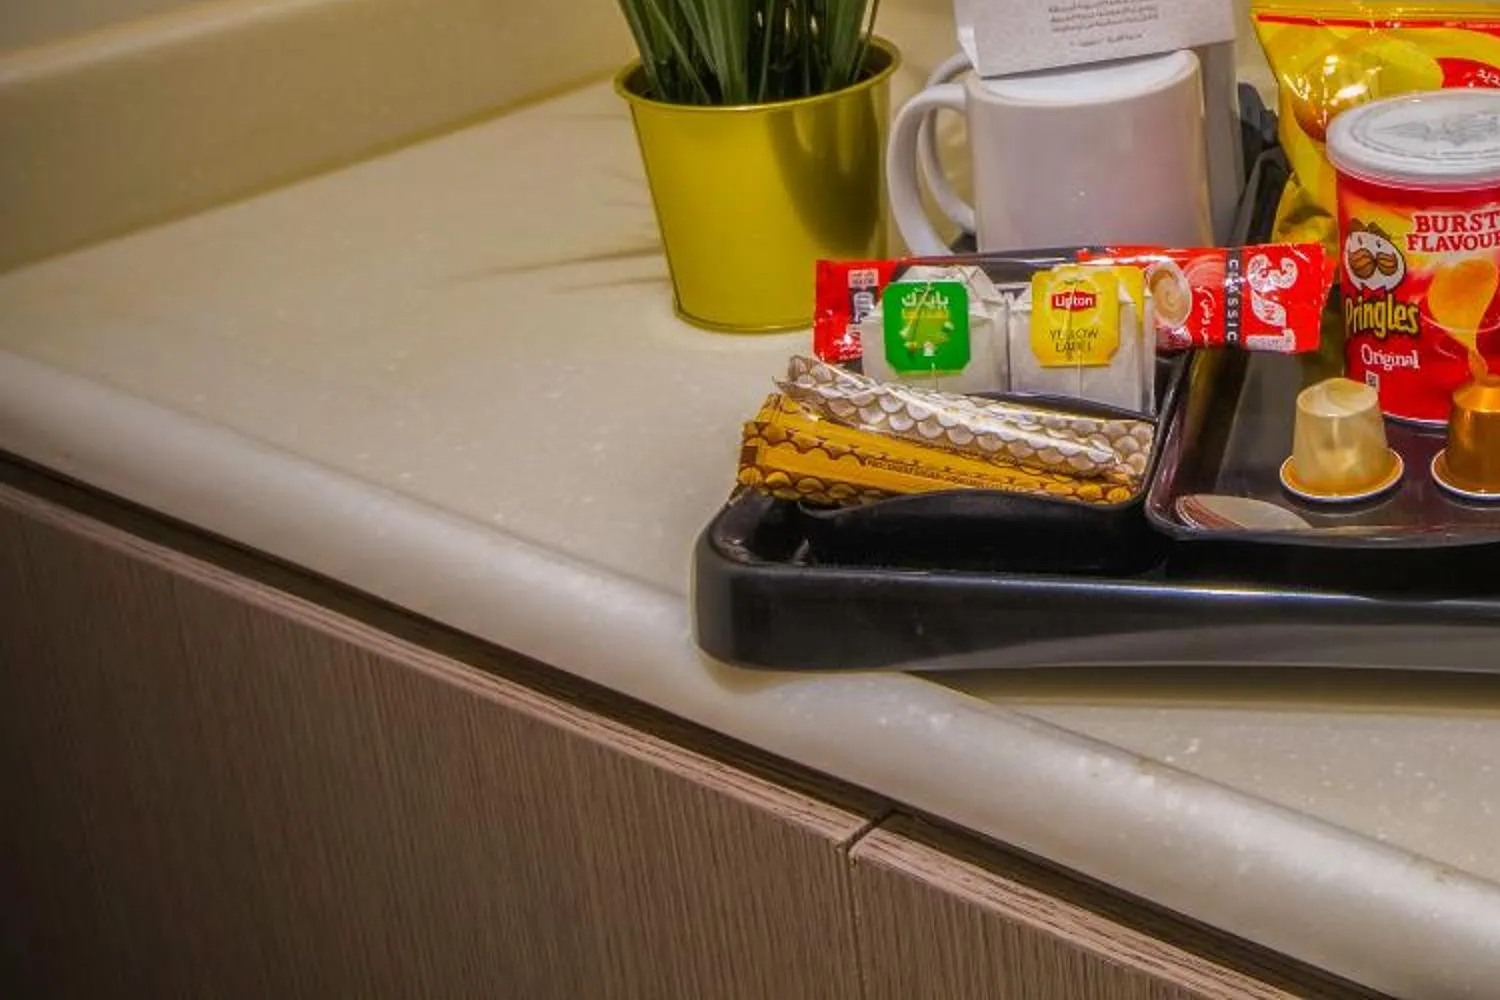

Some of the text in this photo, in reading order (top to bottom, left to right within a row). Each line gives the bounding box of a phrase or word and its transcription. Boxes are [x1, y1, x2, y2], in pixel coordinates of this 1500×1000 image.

[1055, 294, 1094, 311] Lipton
[1345, 293, 1419, 339] Pringles
[1361, 343, 1420, 371] Original
